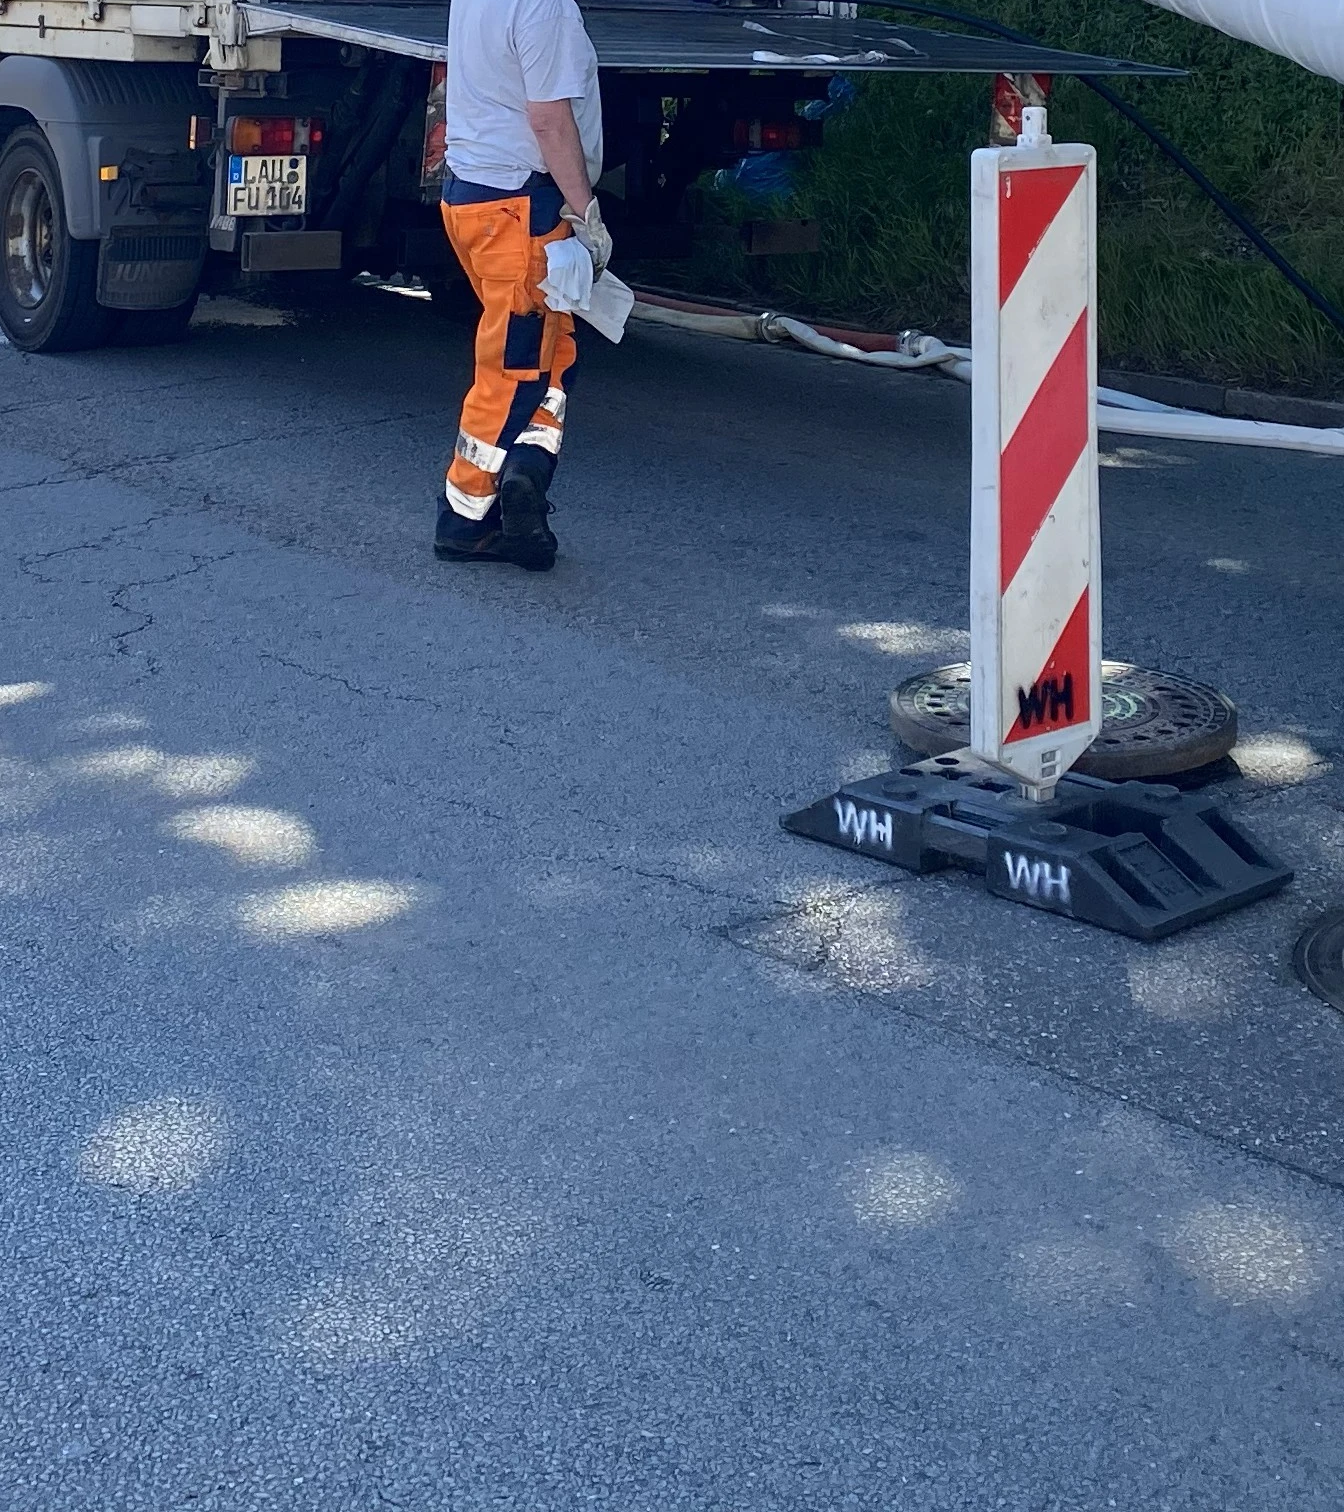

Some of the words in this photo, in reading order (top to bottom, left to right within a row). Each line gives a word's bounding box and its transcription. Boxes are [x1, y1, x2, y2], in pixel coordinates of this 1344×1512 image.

[243, 159, 283, 184] LAU
[233, 187, 260, 211] FU
[1018, 671, 1074, 728] WH
[833, 798, 893, 851] WH
[1004, 850, 1072, 905] WH
